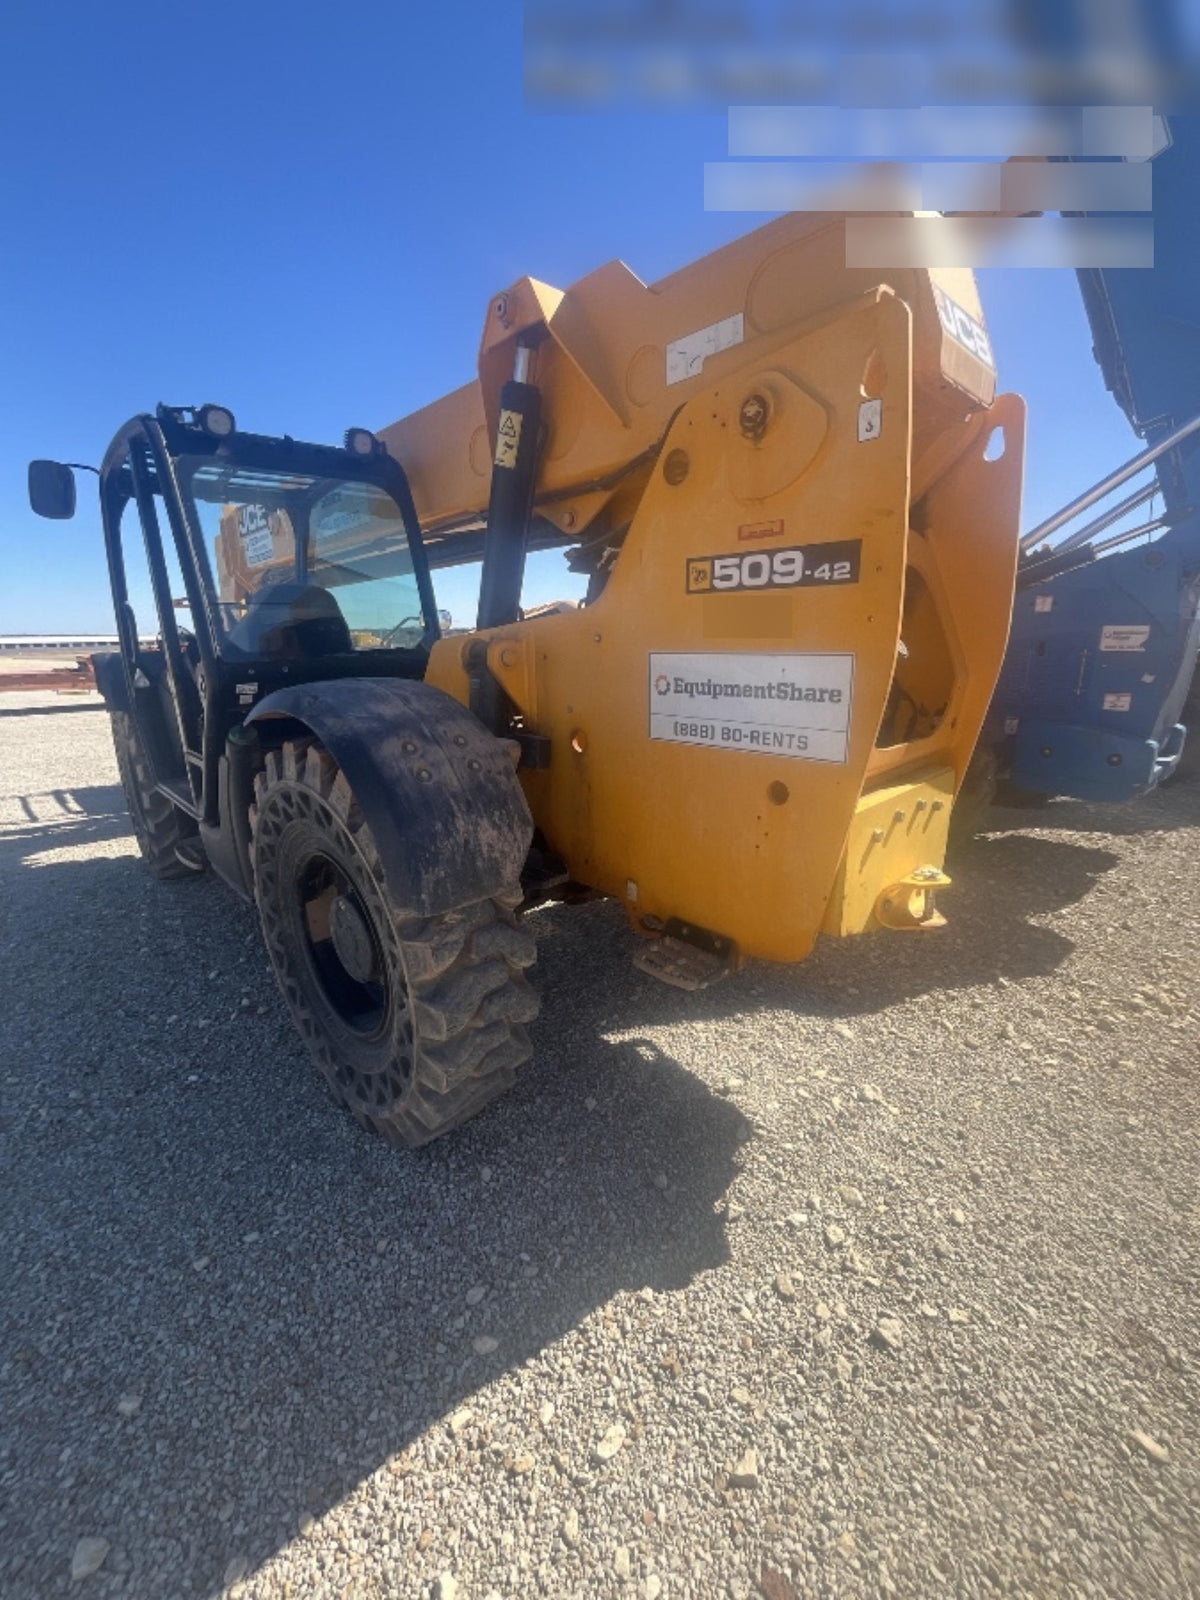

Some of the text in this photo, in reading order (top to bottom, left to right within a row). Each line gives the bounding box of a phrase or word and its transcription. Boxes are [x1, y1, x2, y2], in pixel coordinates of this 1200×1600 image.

[939, 296, 994, 368] JCB
[712, 550, 852, 589] 509-42
[673, 677, 842, 704] EquipmentShare
